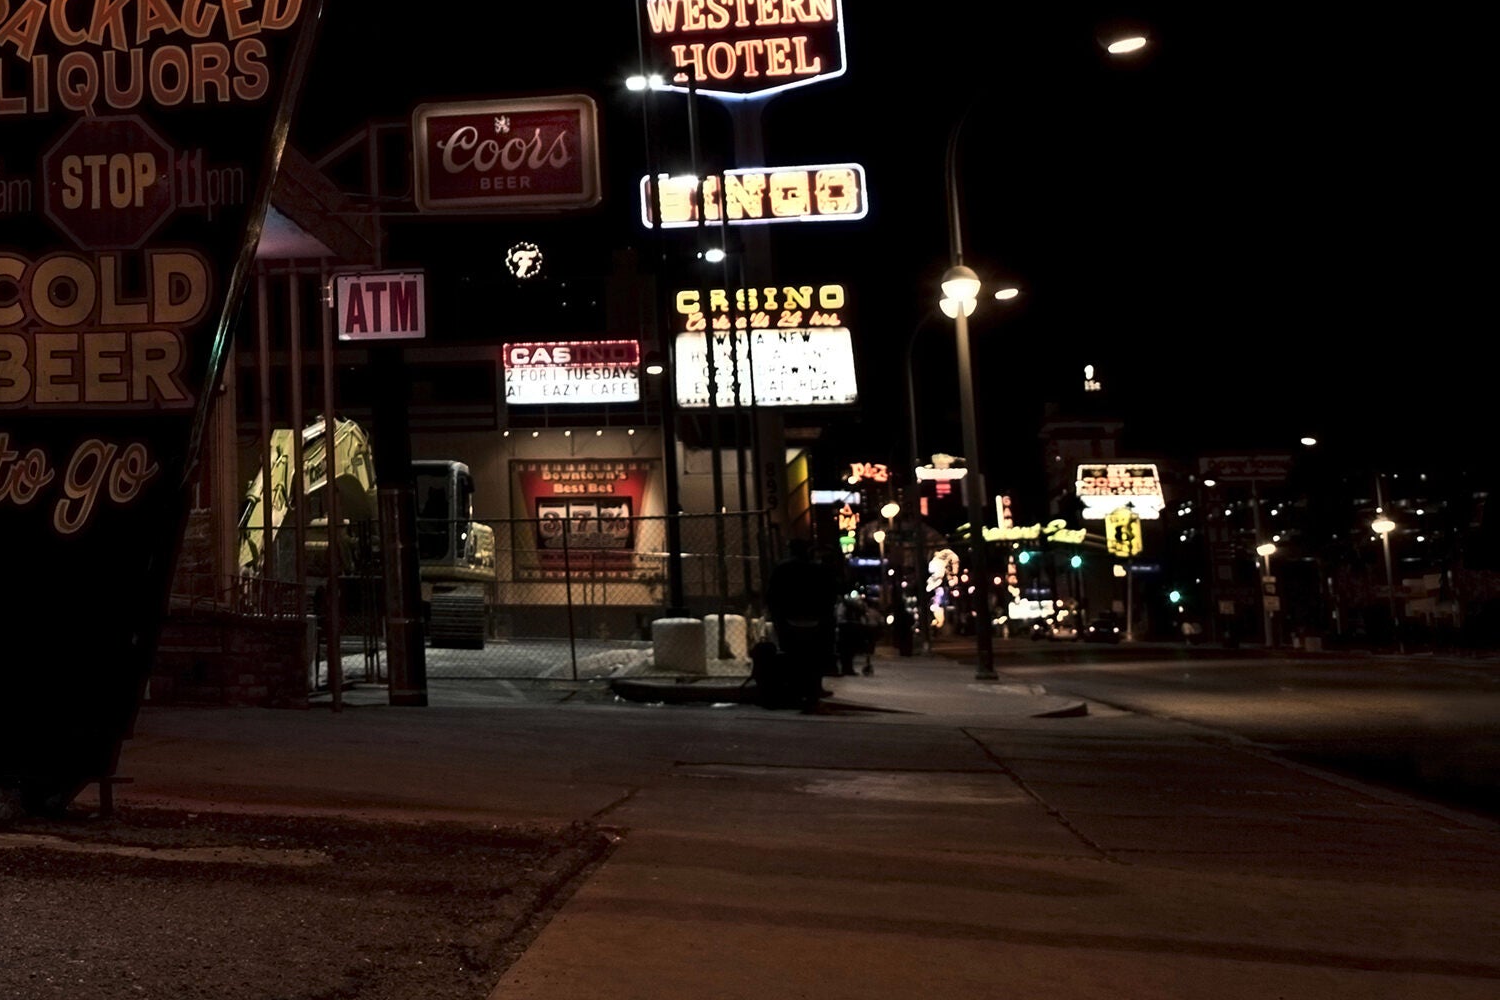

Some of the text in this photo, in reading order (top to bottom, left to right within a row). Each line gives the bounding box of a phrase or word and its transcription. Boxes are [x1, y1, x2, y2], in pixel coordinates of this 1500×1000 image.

[671, 36, 821, 83] HOTEL
[436, 125, 572, 174] Coors
[61, 152, 157, 210] STOP
[176, 148, 245, 222] 11pm
[480, 176, 531, 190] BEER
[650, 168, 858, 222] BINGO
[344, 280, 419, 334] ATM
[676, 284, 845, 314] CASINO
[506, 369, 514, 382] 2
[521, 369, 547, 382] FOR
[564, 366, 638, 381] TUESDAYS
[510, 346, 628, 366] CASINO
[506, 385, 522, 398] AT
[543, 383, 581, 396] EAZY
[53, 438, 160, 535] go
[542, 470, 629, 481] Downtown's
[553, 482, 615, 494] Best Bet
